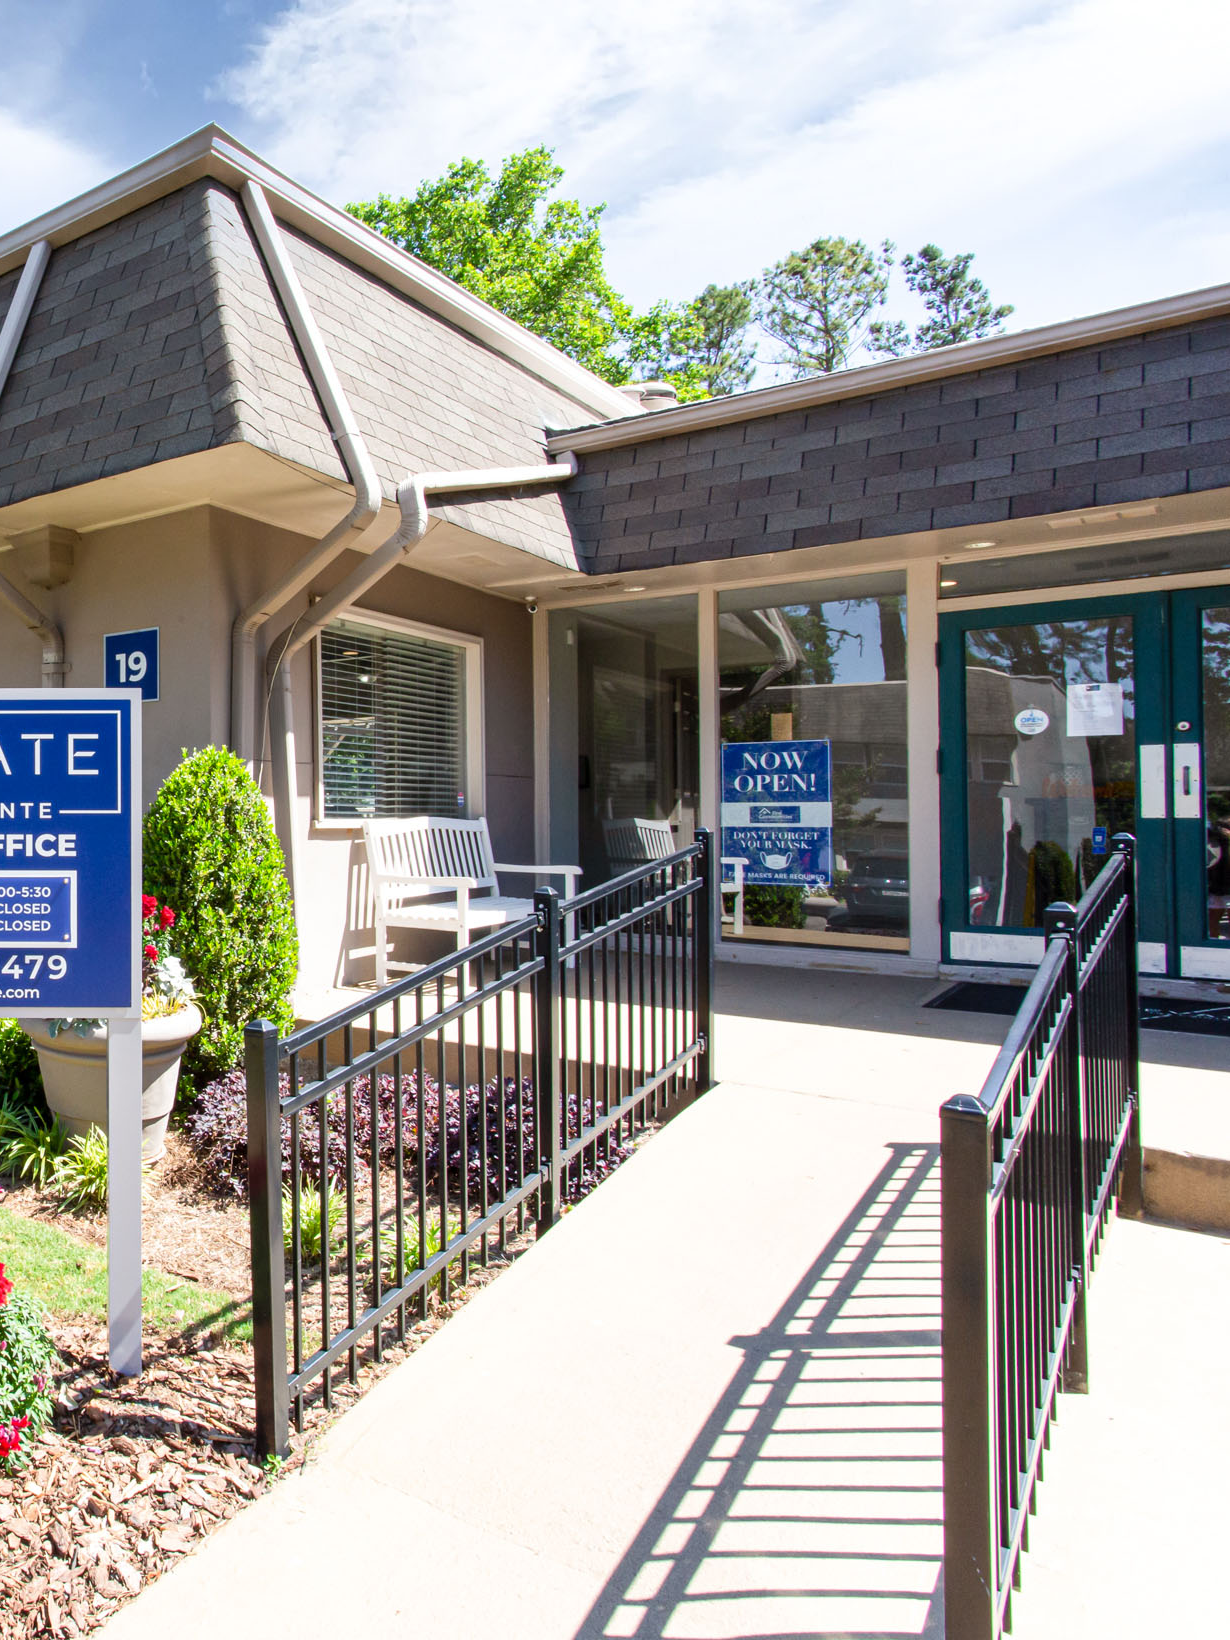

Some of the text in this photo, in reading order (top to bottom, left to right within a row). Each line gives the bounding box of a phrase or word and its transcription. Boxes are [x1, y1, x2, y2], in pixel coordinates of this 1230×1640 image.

[115, 650, 147, 683] 19
[743, 752, 807, 770] NOW
[734, 774, 816, 792] OPEN!
[740, 841, 812, 849] YOUR MASK.
[772, 832, 819, 840] FORGET
